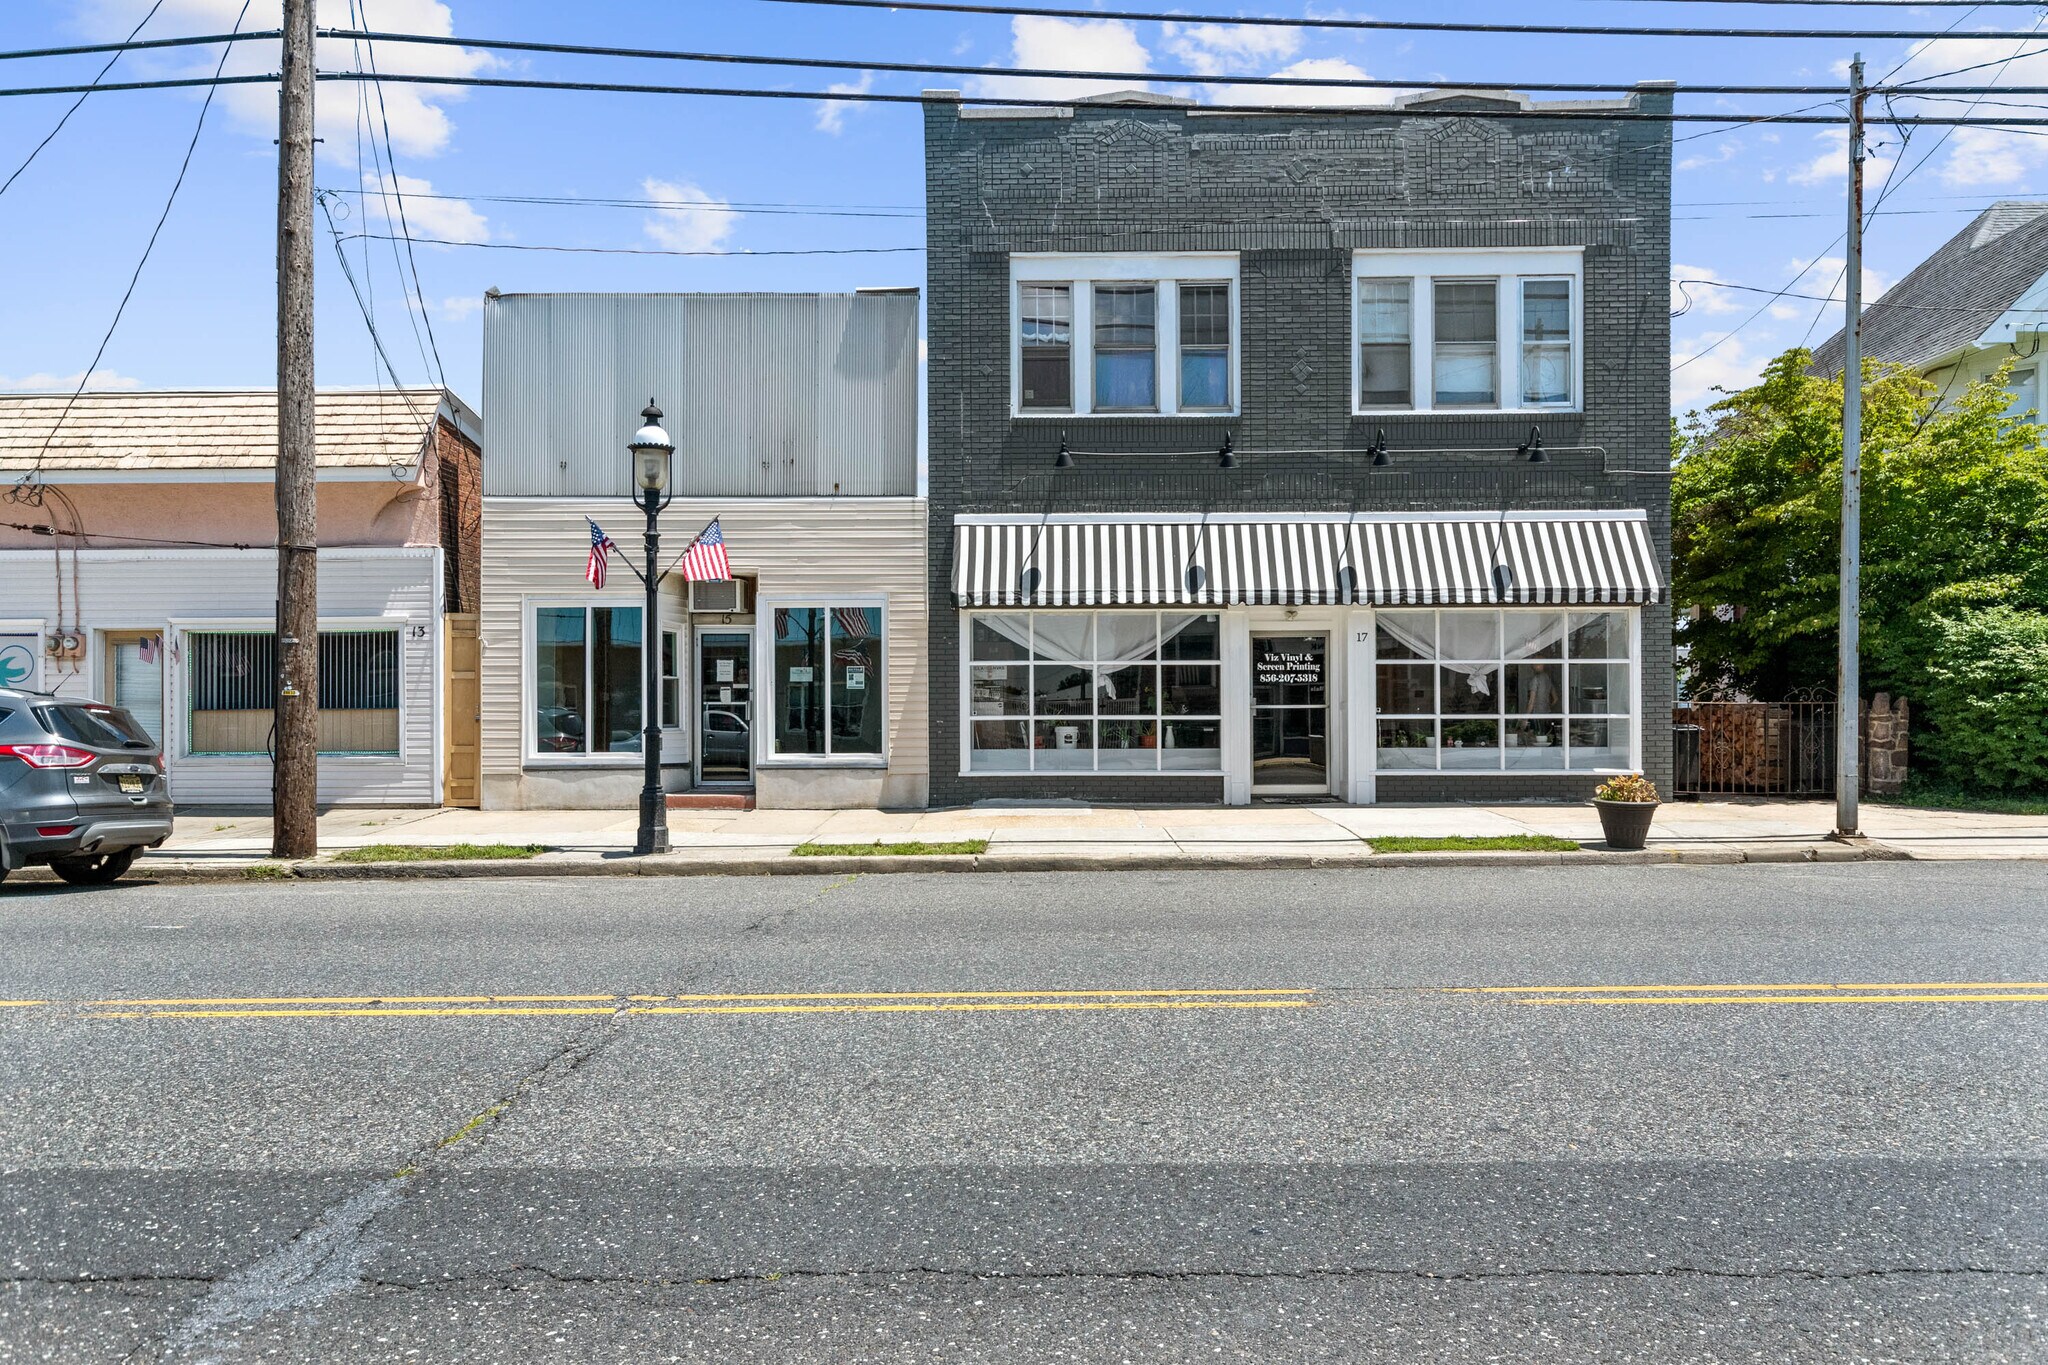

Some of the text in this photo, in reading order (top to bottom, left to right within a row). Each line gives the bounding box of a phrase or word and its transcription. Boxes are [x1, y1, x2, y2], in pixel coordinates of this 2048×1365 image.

[721, 614, 732, 624] 15
[412, 626, 425, 637] 13
[1356, 633, 1368, 642] 17
[1264, 653, 1314, 663] Viz Vinyl &
[1257, 662, 1320, 672] Screen Printing
[1260, 674, 1318, 683] 856-207-5318
